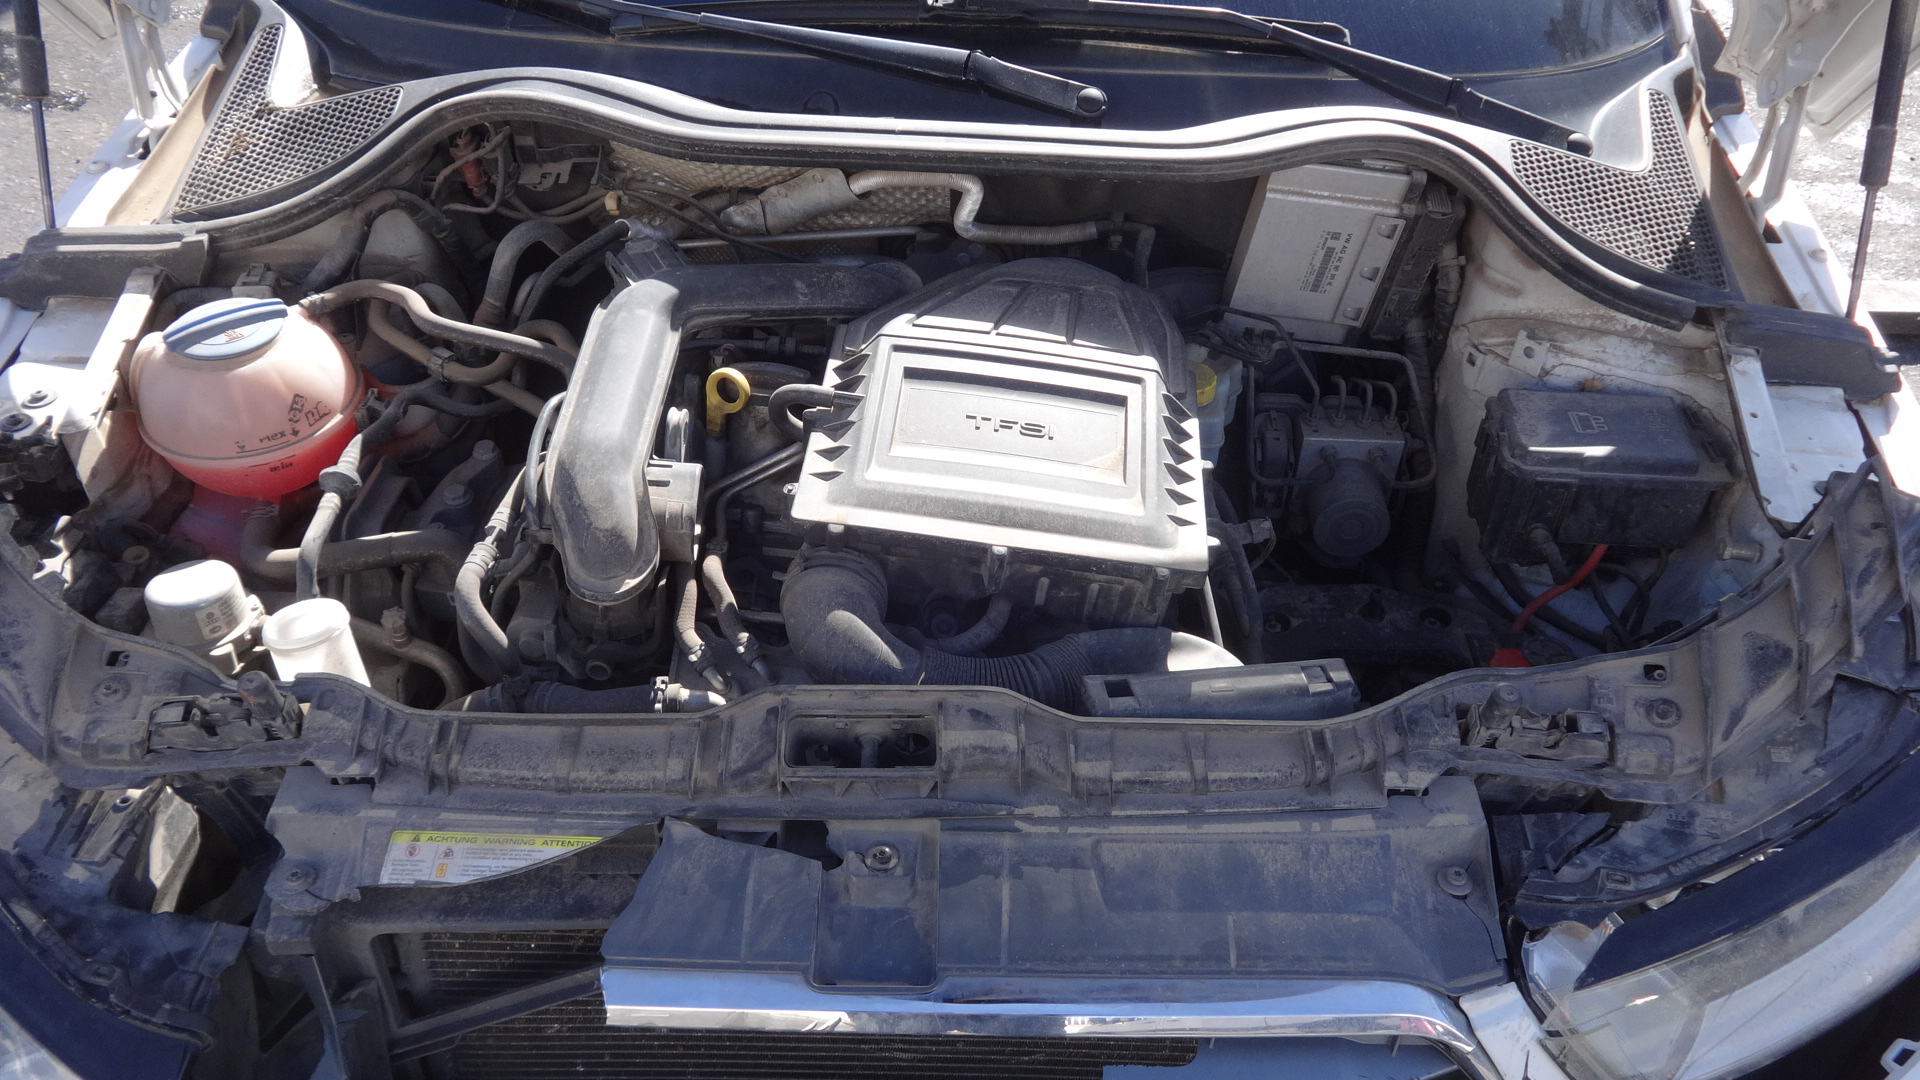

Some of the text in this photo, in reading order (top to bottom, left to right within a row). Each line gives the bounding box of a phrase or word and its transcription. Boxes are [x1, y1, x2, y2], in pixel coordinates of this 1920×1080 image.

[1344, 233, 1353, 244] VW
[1339, 245, 1348, 254] AG
[965, 413, 1054, 440] TFSI
[425, 835, 596, 848] ACHTUNG WARNING ATTENTIO
